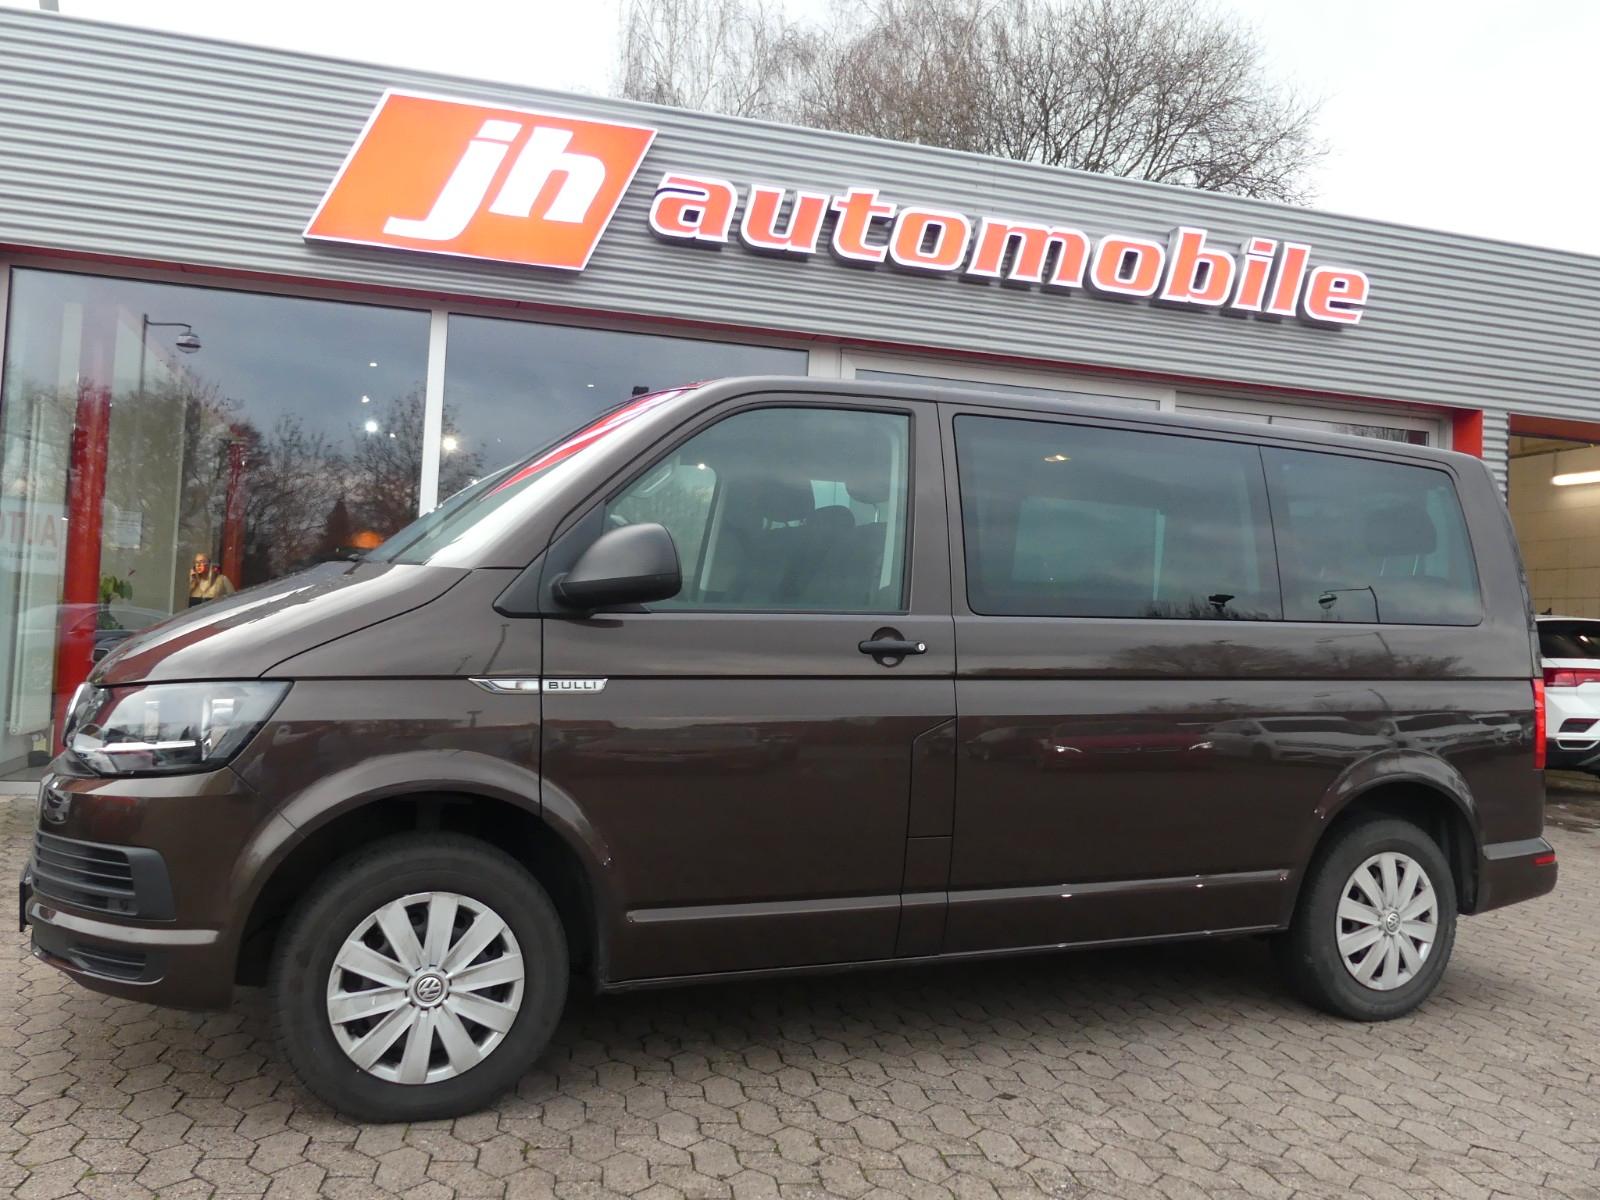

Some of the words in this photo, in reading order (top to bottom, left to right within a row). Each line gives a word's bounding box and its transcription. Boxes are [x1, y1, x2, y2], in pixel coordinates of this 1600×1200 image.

[382, 120, 606, 241] jh
[648, 171, 1370, 325] automobile
[548, 680, 597, 690] BULLI
